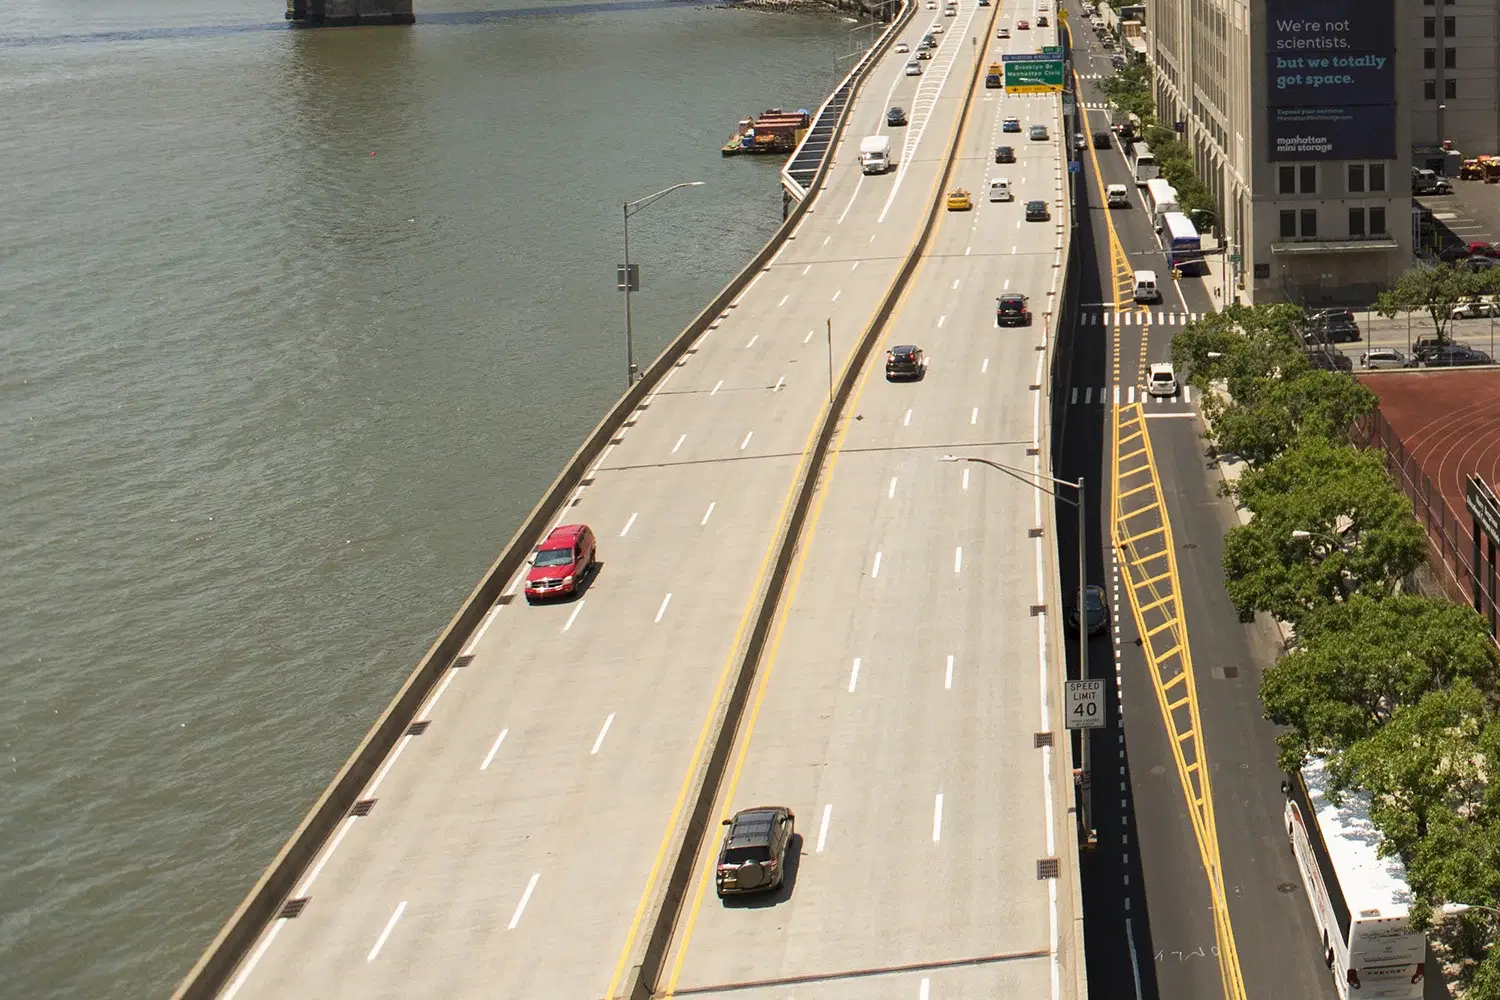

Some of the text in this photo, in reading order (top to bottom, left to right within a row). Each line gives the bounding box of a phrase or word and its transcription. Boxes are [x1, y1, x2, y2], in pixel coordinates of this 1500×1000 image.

[1276, 18, 1350, 33] We're not
[1276, 54, 1386, 69] but we totally
[1276, 72, 1356, 89] got space.
[1277, 134, 1327, 145] manhattan
[1297, 143, 1333, 153] storage
[1070, 682, 1100, 691] SPEED
[1073, 692, 1097, 701] LIMIT
[1073, 702, 1097, 717] 40
